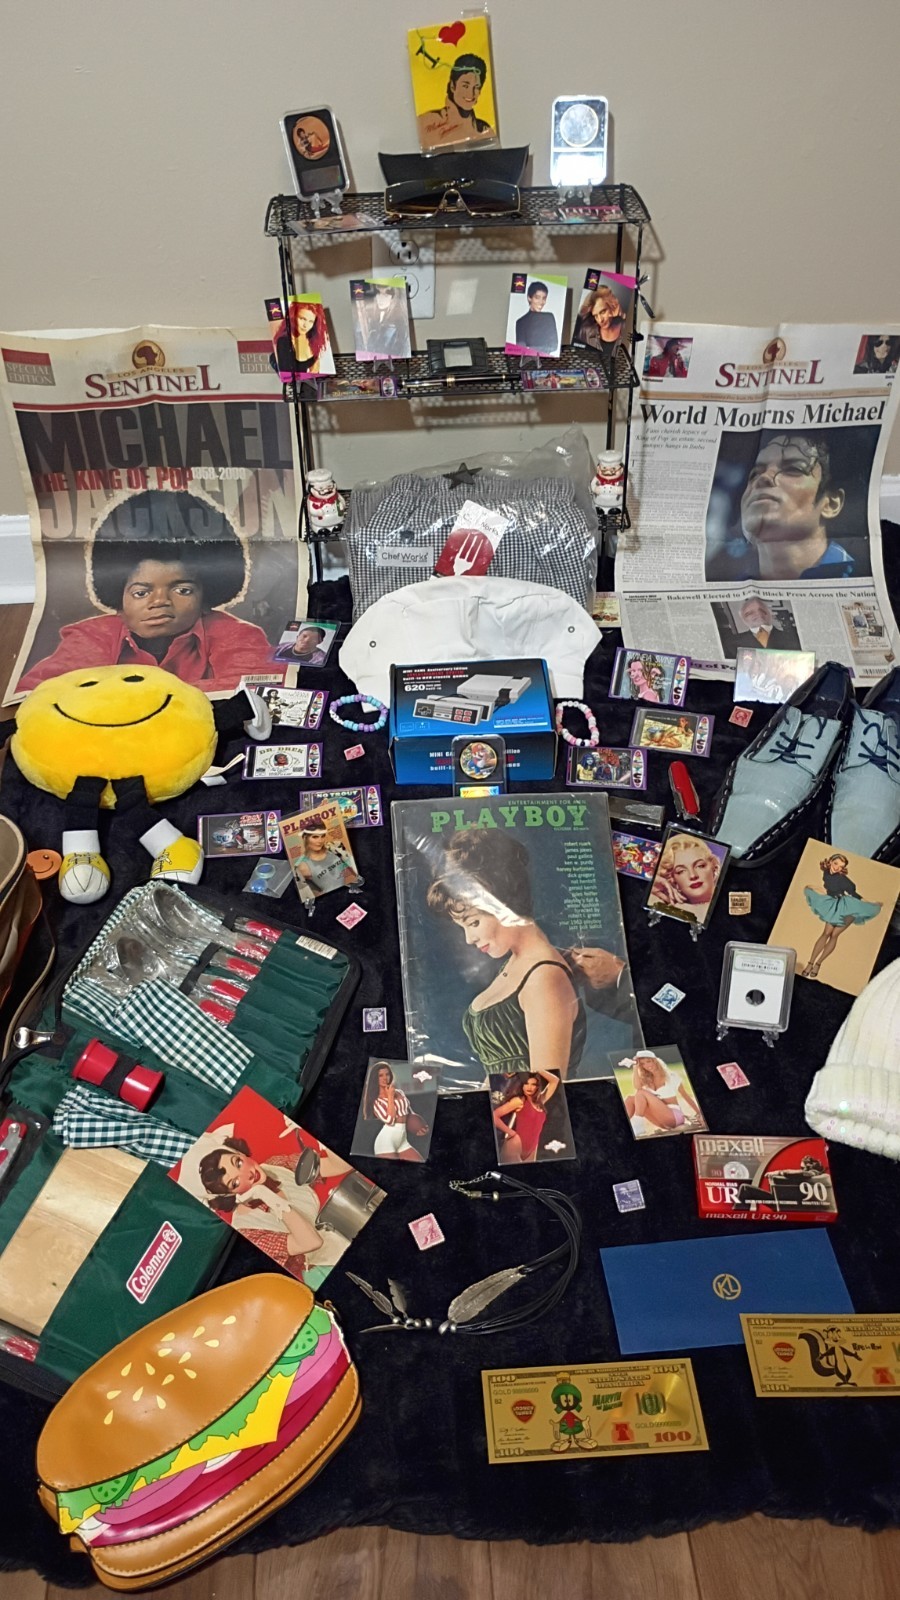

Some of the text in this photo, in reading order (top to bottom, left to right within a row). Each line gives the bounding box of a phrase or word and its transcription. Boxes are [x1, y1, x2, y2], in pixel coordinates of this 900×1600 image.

[6, 363, 51, 375] SPECIAL
[141, 366, 185, 374] ANGELES
[715, 359, 825, 389] SENTINEL
[9, 373, 55, 384] EDITION
[85, 364, 221, 399] SENTINEL
[640, 400, 886, 427] World Mourns Michael
[15, 402, 294, 472] MICHAEL
[36, 472, 70, 492] THE
[75, 468, 122, 491] KING
[126, 467, 150, 490] OF
[156, 466, 194, 490] POP
[39, 468, 297, 540] JACKSON
[381, 552, 429, 561] Chef Works
[702, 592, 731, 600] Elected
[761, 590, 784, 599] Black
[849, 591, 877, 599] Nation
[404, 684, 426, 692] 620
[329, 790, 359, 798] TROUT
[282, 806, 337, 835] PLAYBOY
[430, 804, 588, 833] PLAYBOY
[699, 1137, 765, 1153] maxell
[706, 1186, 742, 1204] UR
[799, 1181, 828, 1202] 90
[131, 1241, 170, 1293] Coleman
[749, 1318, 775, 1326] 100
[491, 1375, 516, 1384] 100
[651, 1365, 680, 1375] 100
[635, 1421, 654, 1429] GOLD
[654, 1430, 692, 1443] 100
